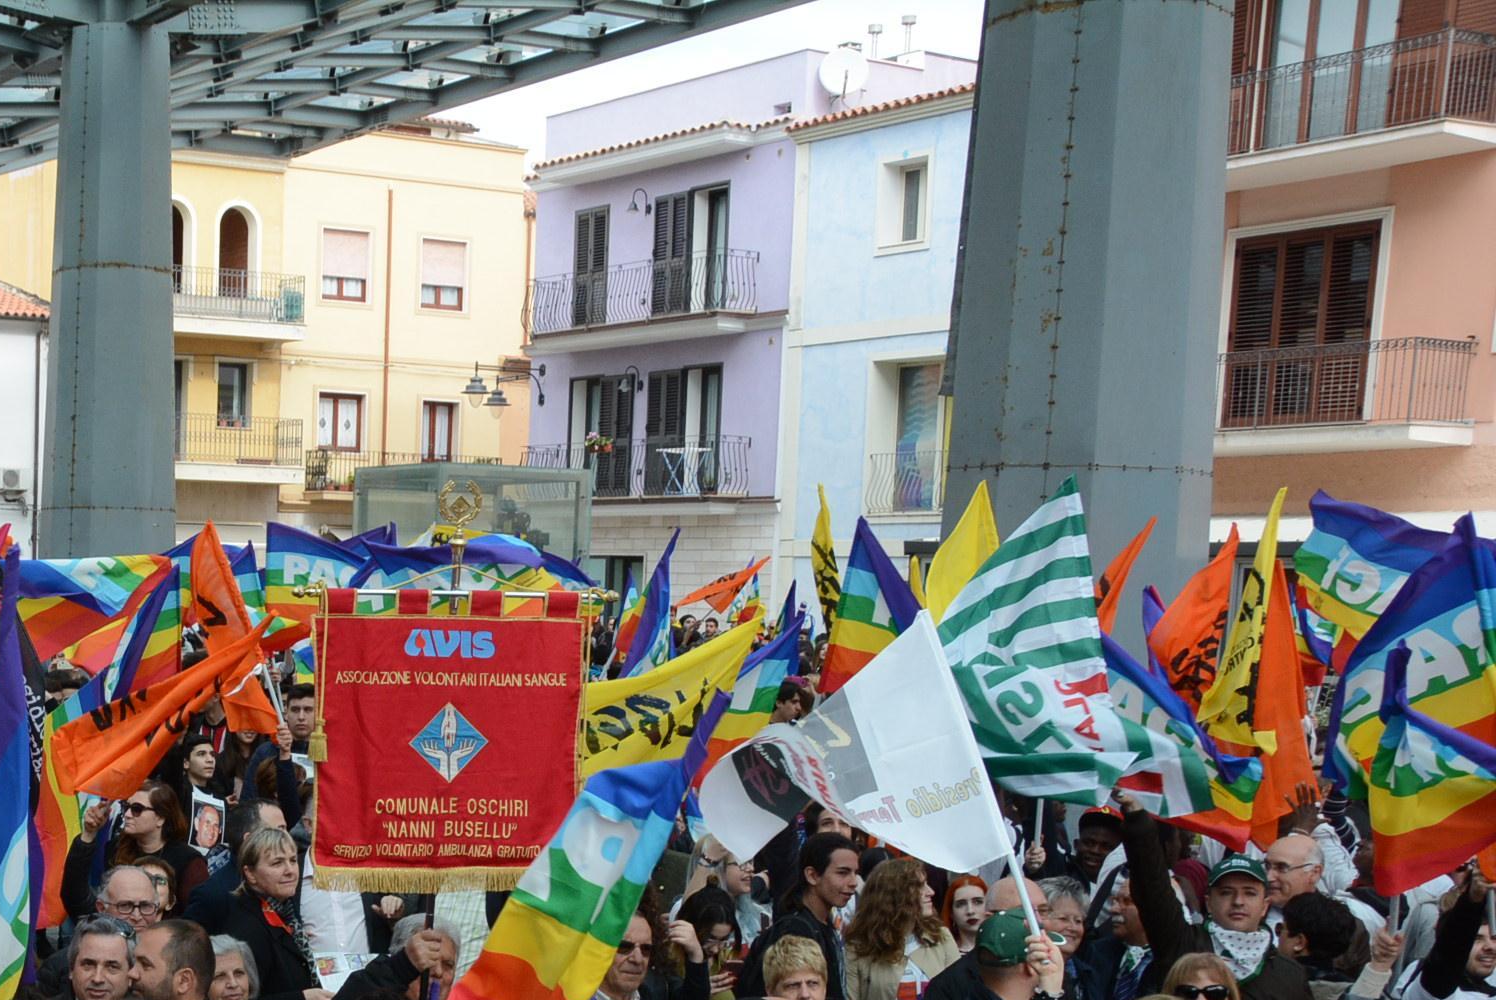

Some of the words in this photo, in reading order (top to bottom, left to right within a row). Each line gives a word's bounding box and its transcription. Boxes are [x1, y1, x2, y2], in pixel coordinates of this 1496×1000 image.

[404, 628, 496, 659] AVIS
[335, 670, 411, 685] ASSOCIAZIONE
[414, 671, 478, 687] VOLONTARI
[479, 672, 523, 687] ITALIANI
[524, 672, 567, 687] SANGUE
[375, 797, 458, 815] COMUNALE
[467, 798, 529, 816] OSCHIRI
[333, 844, 372, 859] SERVIZIO
[376, 843, 434, 858] VOLONTARIO
[437, 844, 493, 858] AMBULANZA
[497, 844, 541, 858] GRATUITO
